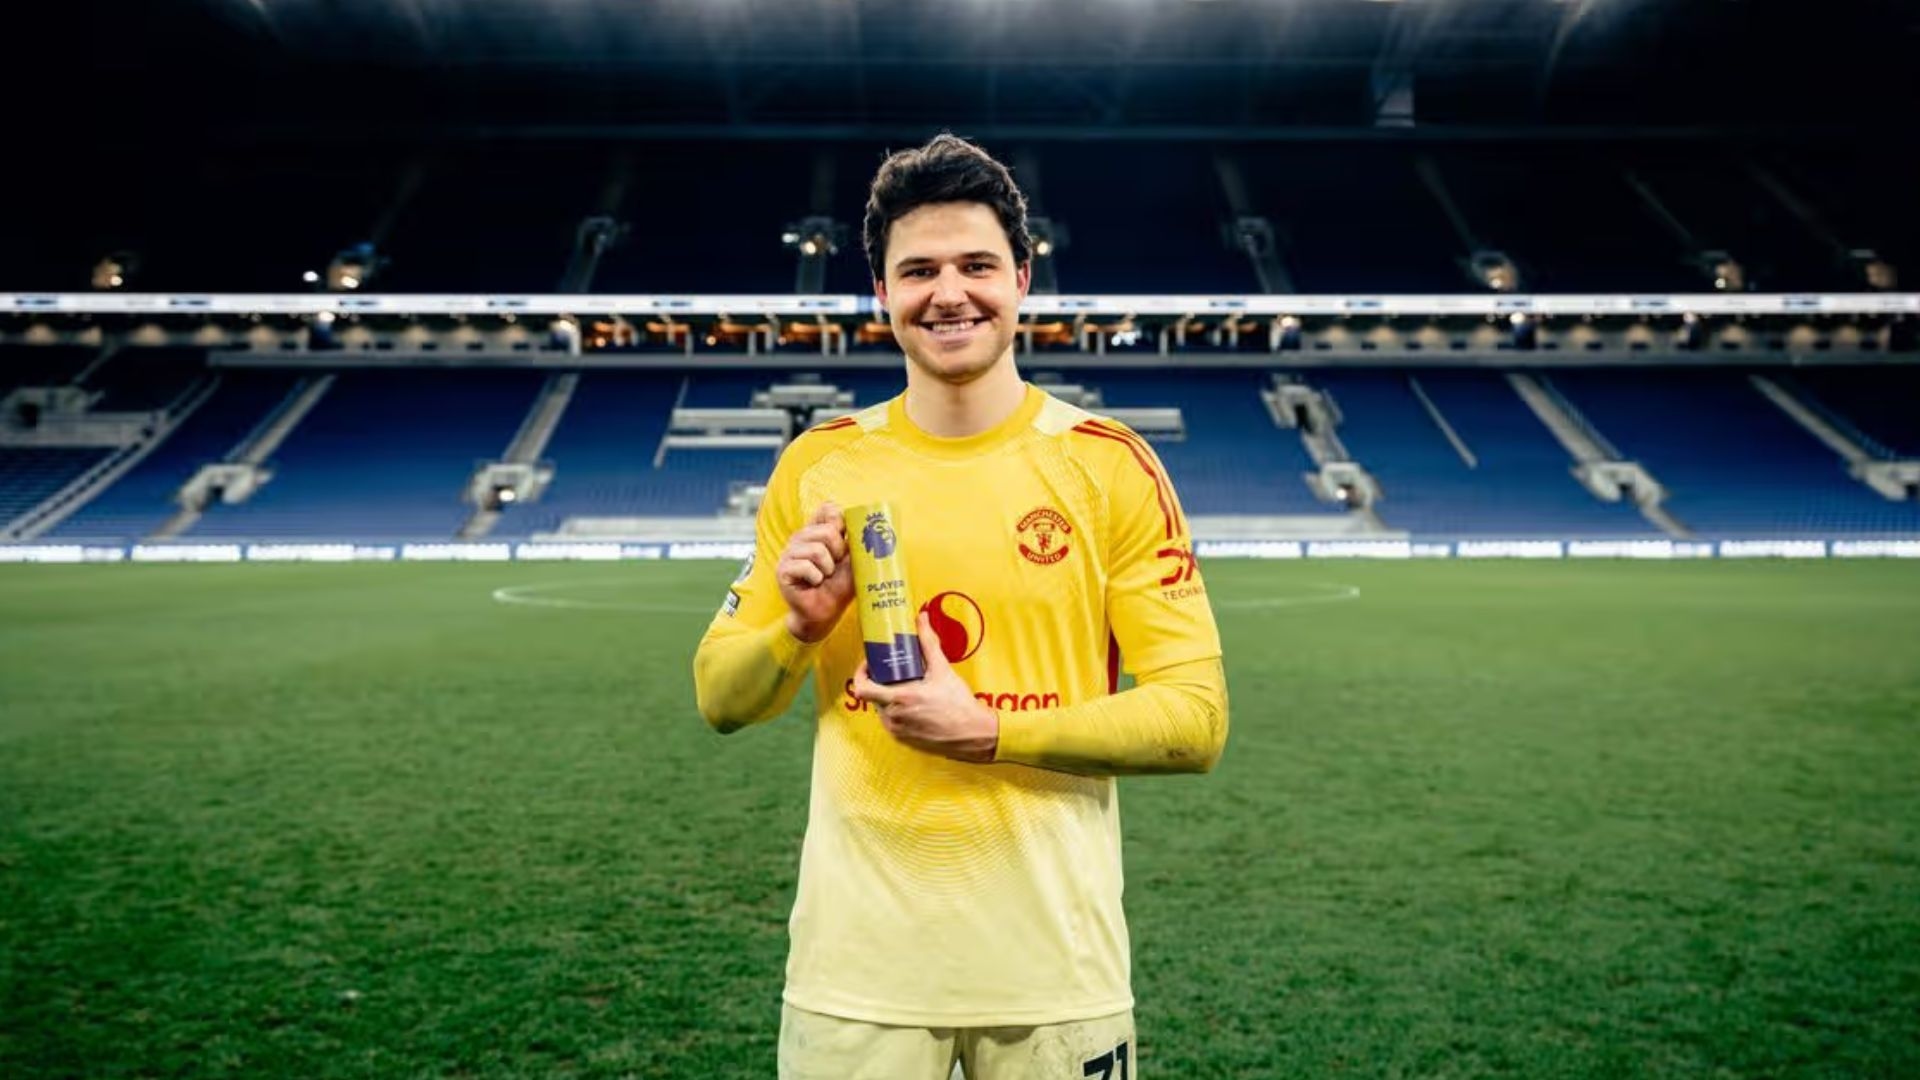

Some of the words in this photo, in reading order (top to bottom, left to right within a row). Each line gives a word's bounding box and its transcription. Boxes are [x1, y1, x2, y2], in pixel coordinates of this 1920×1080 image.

[1018, 510, 1069, 531] MANCHESTER
[1026, 552, 1062, 564] UNITED
[867, 579, 905, 592] PLAYER
[872, 597, 906, 610] MATCH
[1083, 1040, 1128, 1080] 71
